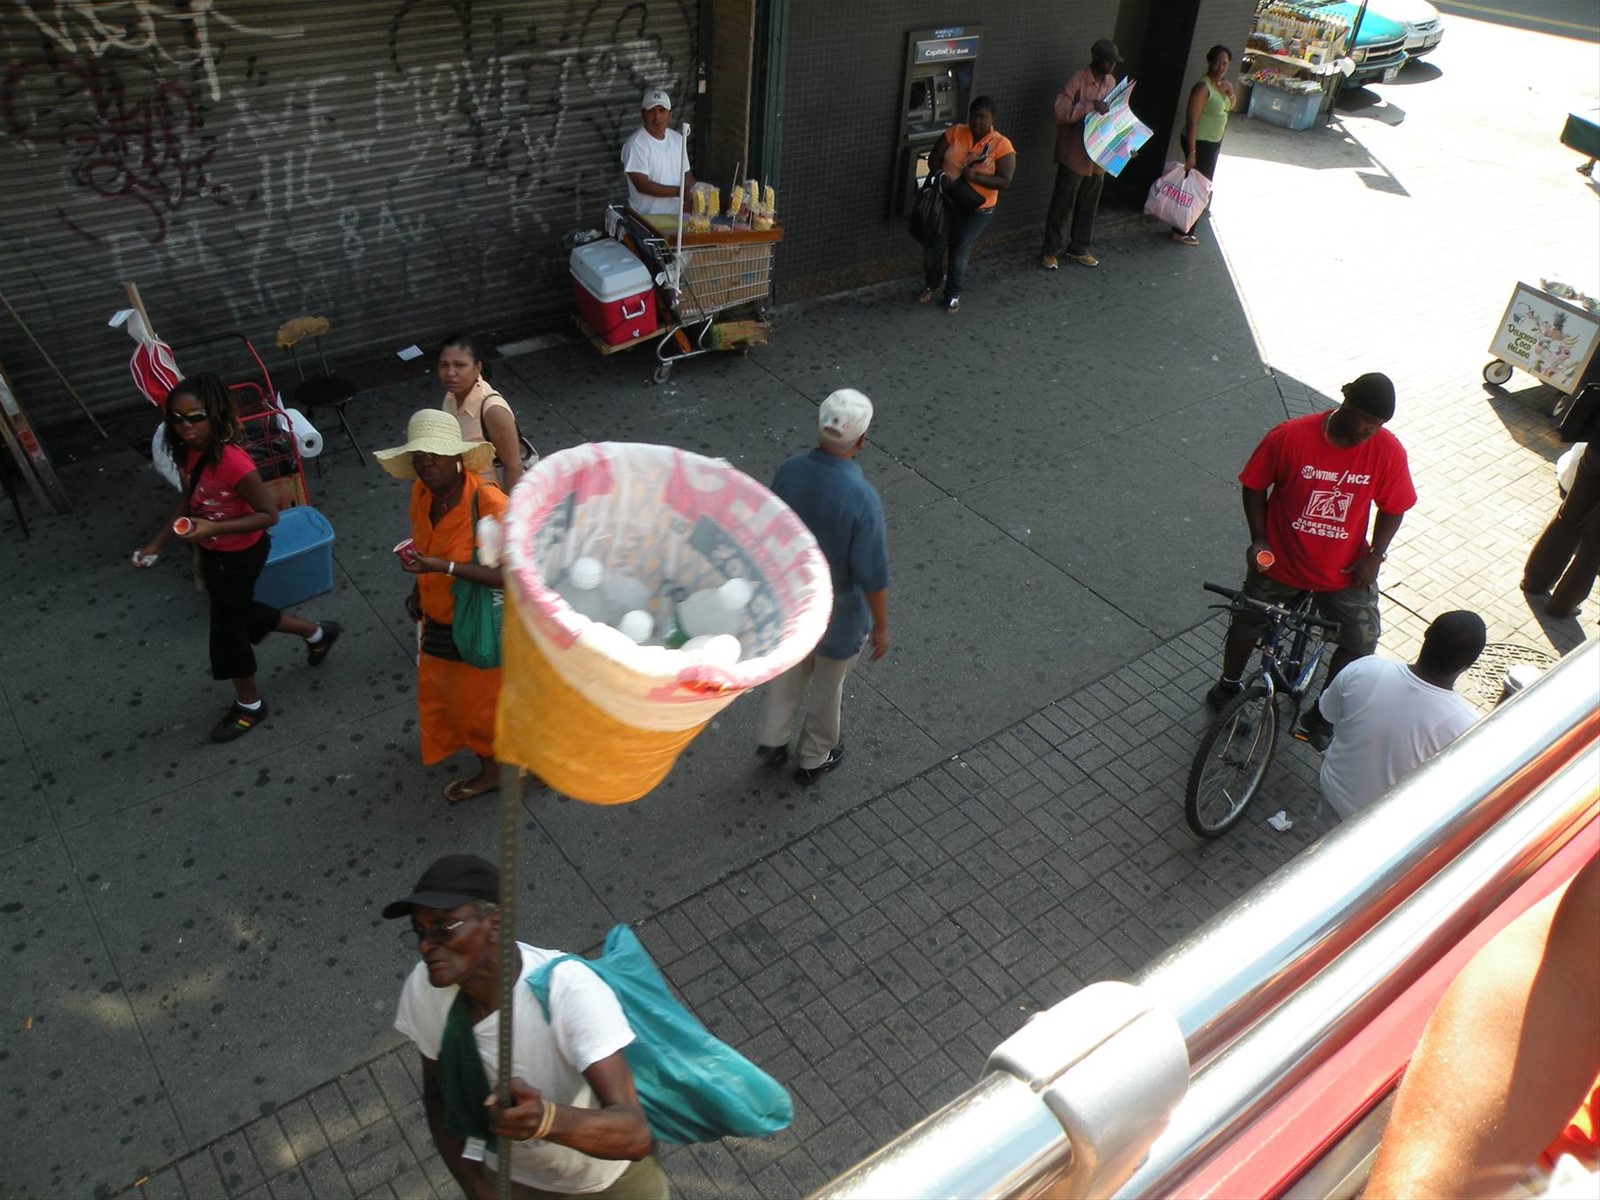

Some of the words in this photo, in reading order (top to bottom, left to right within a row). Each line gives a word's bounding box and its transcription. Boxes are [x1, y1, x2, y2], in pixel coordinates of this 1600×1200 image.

[1161, 182, 1193, 206] CONWAY
[1291, 521, 1349, 539] CLASSIC
[1297, 517, 1346, 533] BASKETBALL
